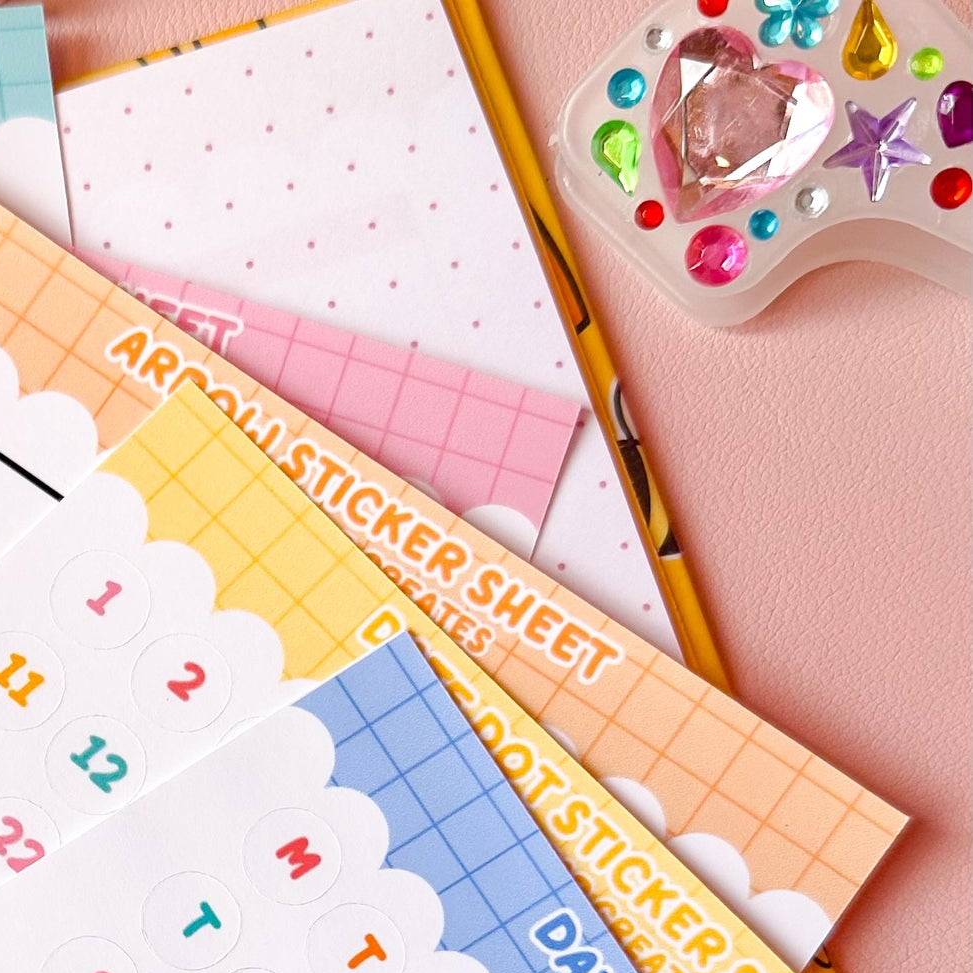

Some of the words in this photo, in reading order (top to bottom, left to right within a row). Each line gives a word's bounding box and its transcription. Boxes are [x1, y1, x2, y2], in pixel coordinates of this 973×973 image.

[279, 443, 467, 582] STICKER
[466, 569, 619, 680] SHEET
[87, 581, 121, 615] 1
[167, 662, 206, 701] 2
[71, 736, 127, 792] 12
[276, 836, 322, 880] M
[475, 712, 565, 802] DOT
[552, 800, 727, 968] STICKER
[183, 902, 221, 937] T
[347, 933, 387, 970] T
